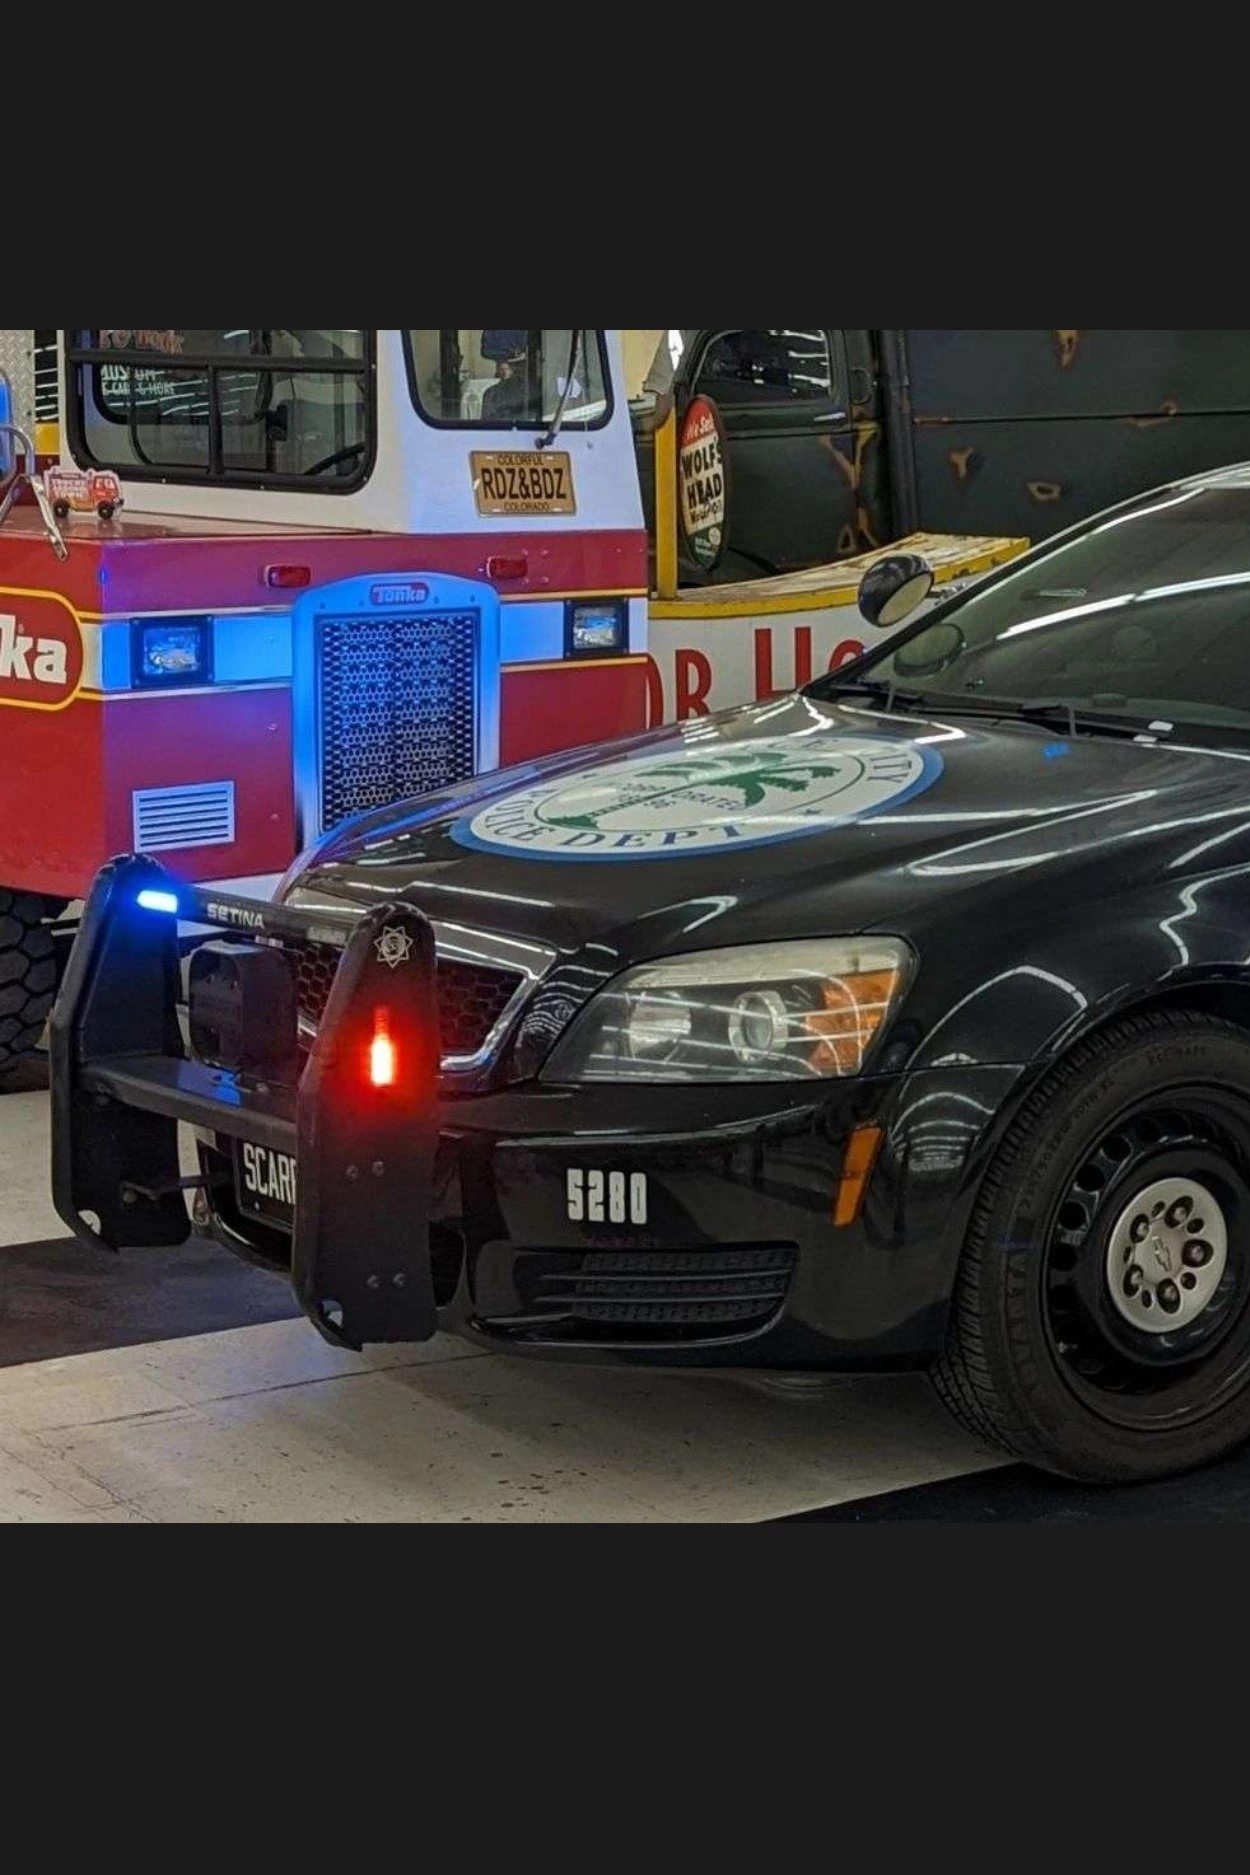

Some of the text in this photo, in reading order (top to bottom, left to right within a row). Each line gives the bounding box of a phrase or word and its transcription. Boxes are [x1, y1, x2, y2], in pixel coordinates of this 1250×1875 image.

[497, 455, 545, 466] COLORFUL
[481, 468, 568, 499] RDZ&BDZ
[686, 472, 722, 508] HEAD
[503, 502, 551, 512] COLORADO
[373, 585, 427, 603] Tonka
[559, 823, 746, 848] DEPT
[206, 902, 266, 930] SETINA
[566, 1168, 648, 1225] 5280
